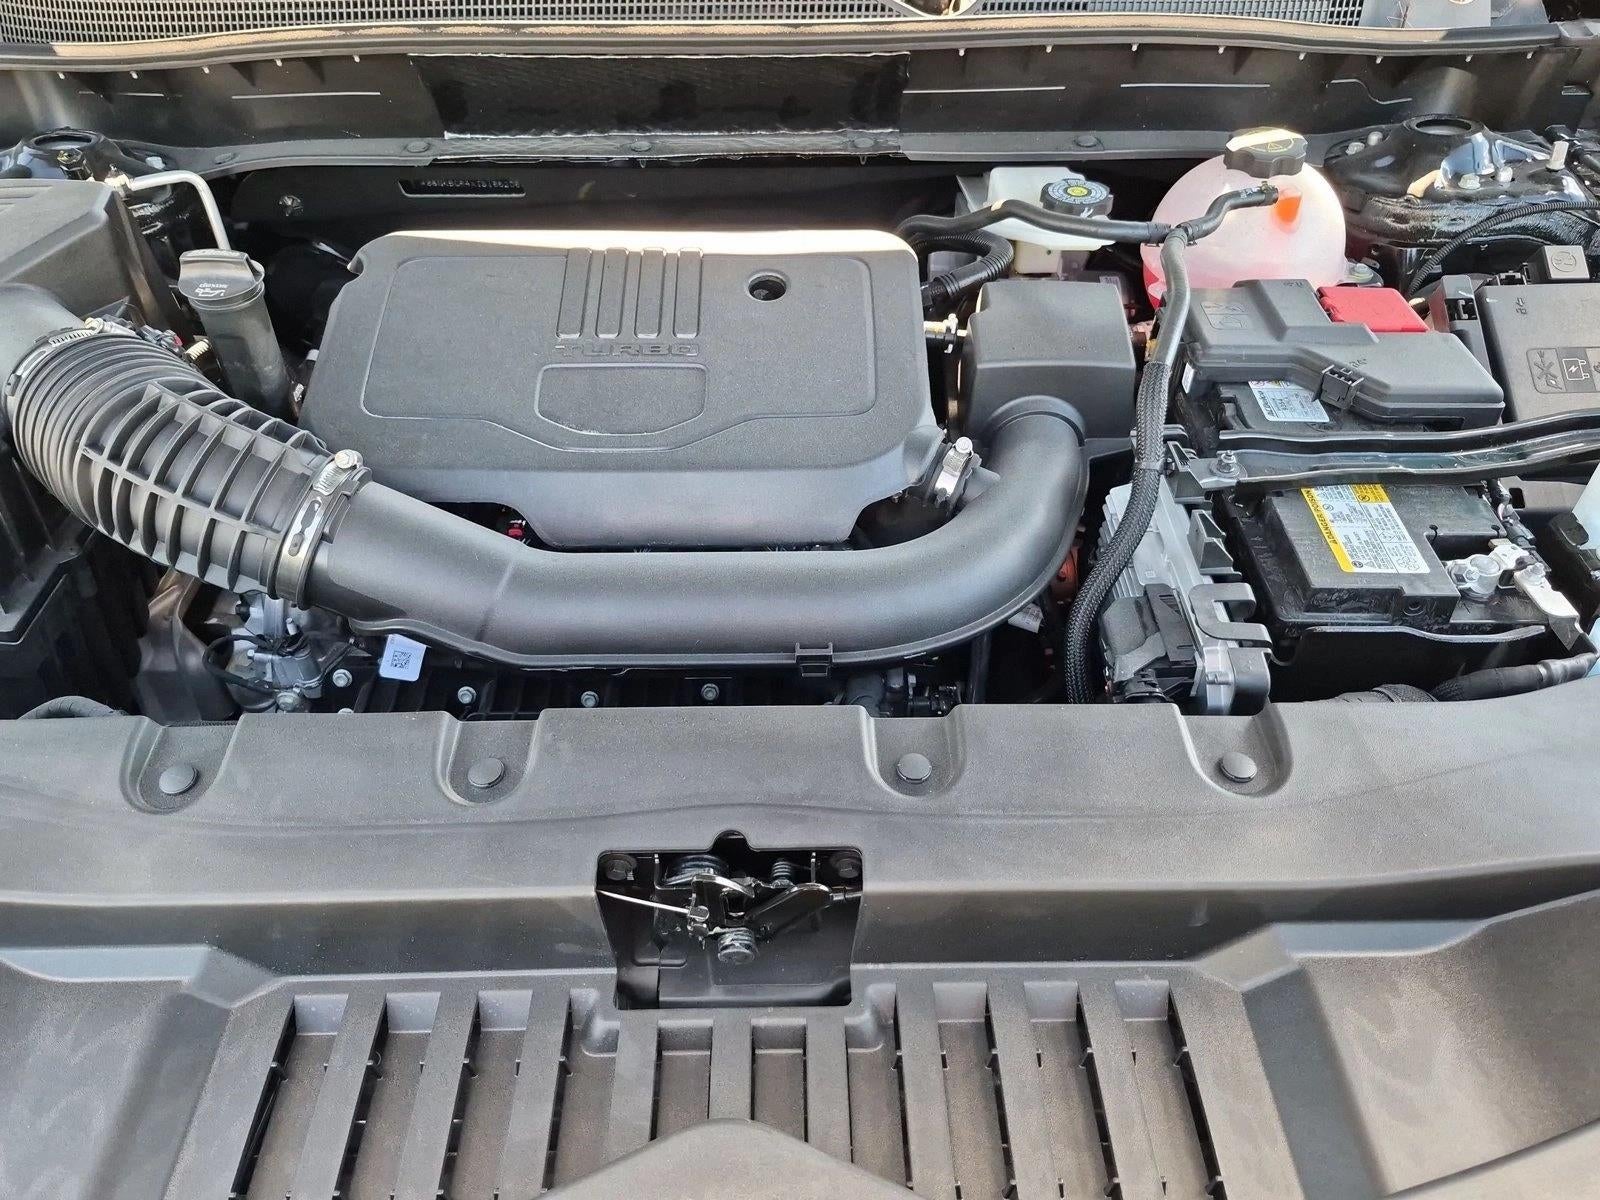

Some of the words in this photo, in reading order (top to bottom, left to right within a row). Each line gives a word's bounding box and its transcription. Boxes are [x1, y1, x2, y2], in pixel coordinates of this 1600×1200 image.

[553, 342, 700, 357] TURBO
[1304, 489, 1321, 512] POISON
[1316, 513, 1335, 540] DANGER
